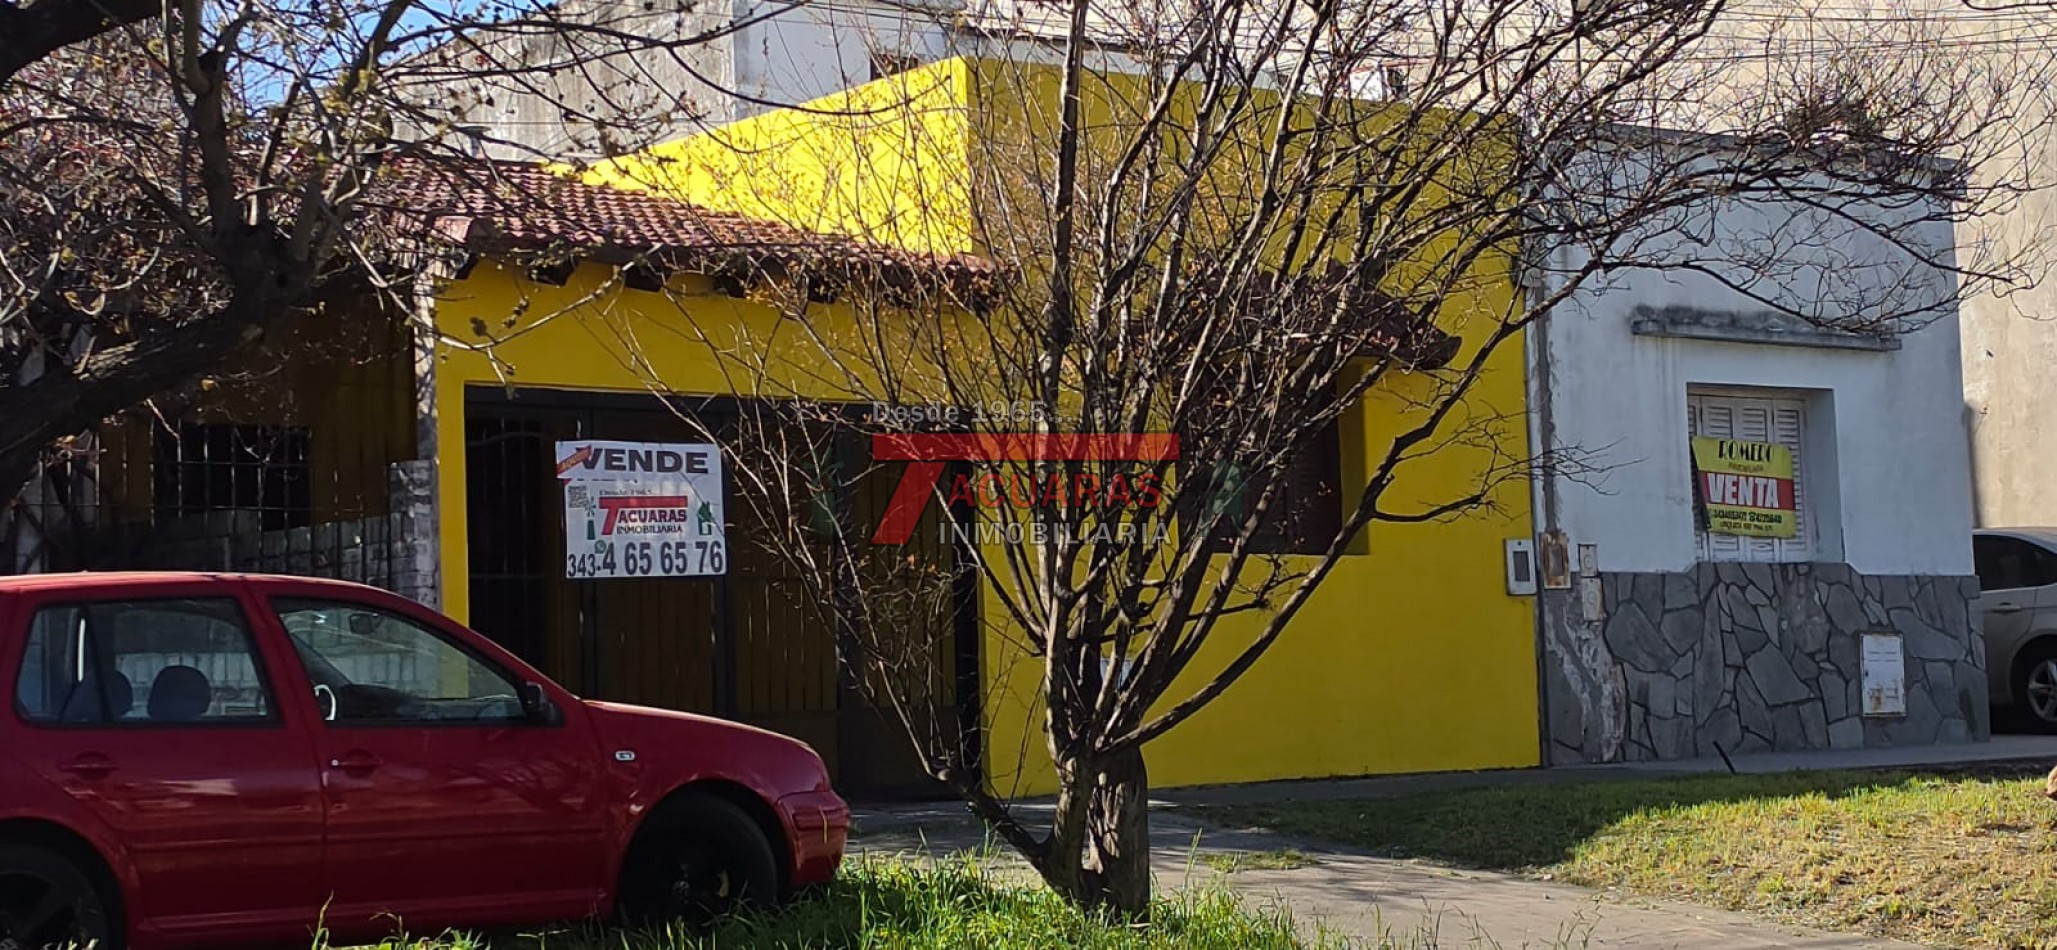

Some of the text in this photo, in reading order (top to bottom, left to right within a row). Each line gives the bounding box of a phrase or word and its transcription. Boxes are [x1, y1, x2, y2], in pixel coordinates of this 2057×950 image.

[577, 448, 708, 474] VENDE
[1718, 440, 1774, 462] ROMERO
[1707, 472, 1779, 508] VENTA
[617, 525, 683, 534] INMOBILIARIA
[624, 542, 652, 575] 65
[660, 541, 688, 574] 65
[695, 540, 723, 573] 76
